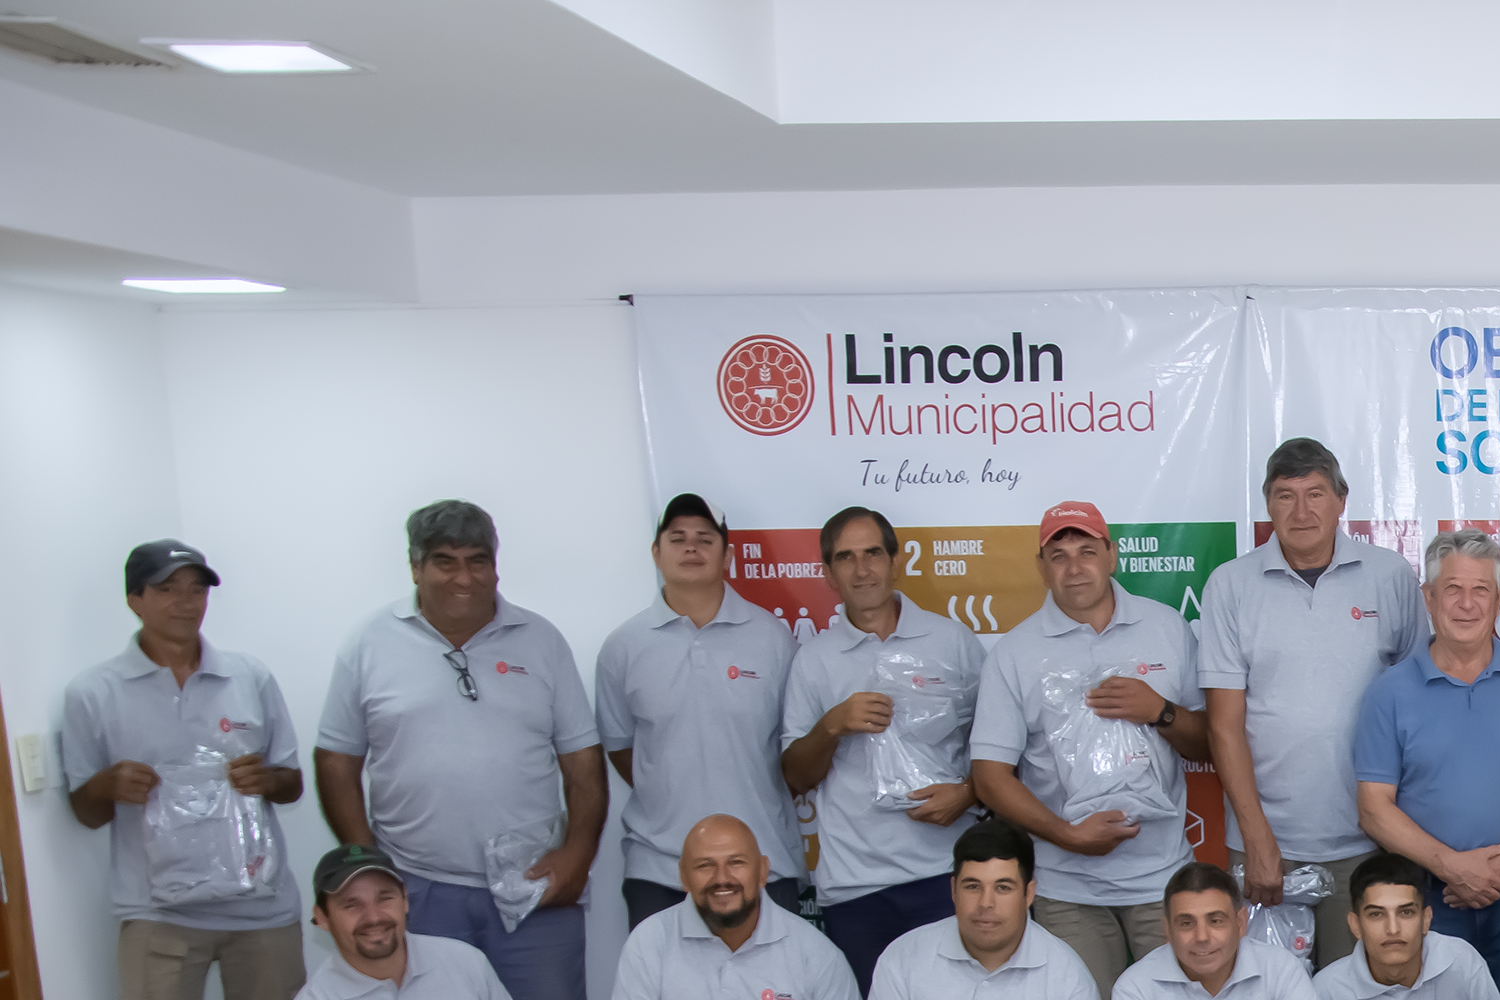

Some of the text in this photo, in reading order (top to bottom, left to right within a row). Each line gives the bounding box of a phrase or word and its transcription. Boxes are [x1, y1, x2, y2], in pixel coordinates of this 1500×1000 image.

[845, 331, 1063, 384] Lincoln
[1436, 389, 1487, 422] DE
[846, 390, 1155, 445] Municipalidad
[860, 458, 1021, 492] Tu futuro, hoy
[742, 543, 762, 558] FIN
[932, 540, 985, 555] HAMBRE
[1118, 536, 1159, 552] SALUD
[904, 540, 922, 576] 2
[1119, 556, 1195, 573] Y BIENESTAR
[744, 563, 760, 579] DE
[761, 563, 777, 579] LA
[934, 560, 966, 576] CERO
